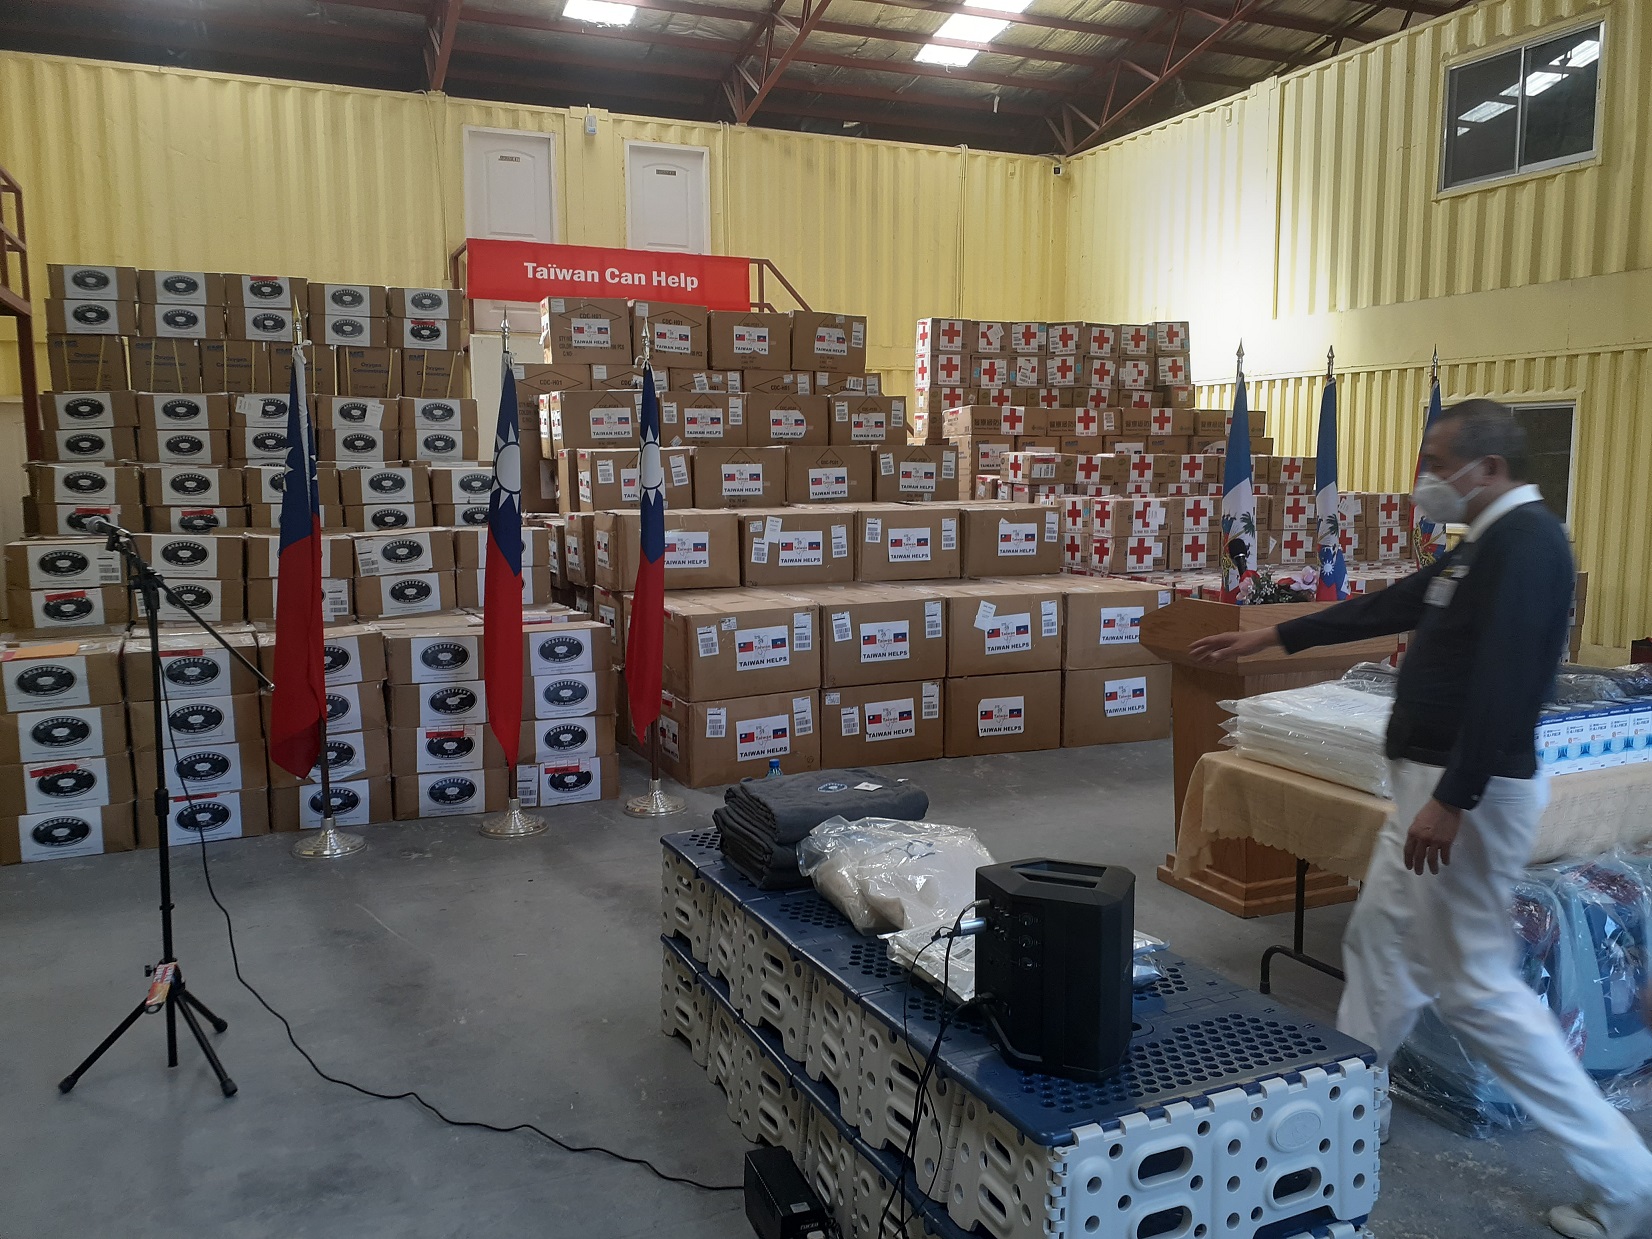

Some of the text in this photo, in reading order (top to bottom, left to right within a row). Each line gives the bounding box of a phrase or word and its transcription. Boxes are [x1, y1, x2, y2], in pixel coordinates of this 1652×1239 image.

[524, 262, 699, 292] Taïwan Can Help
